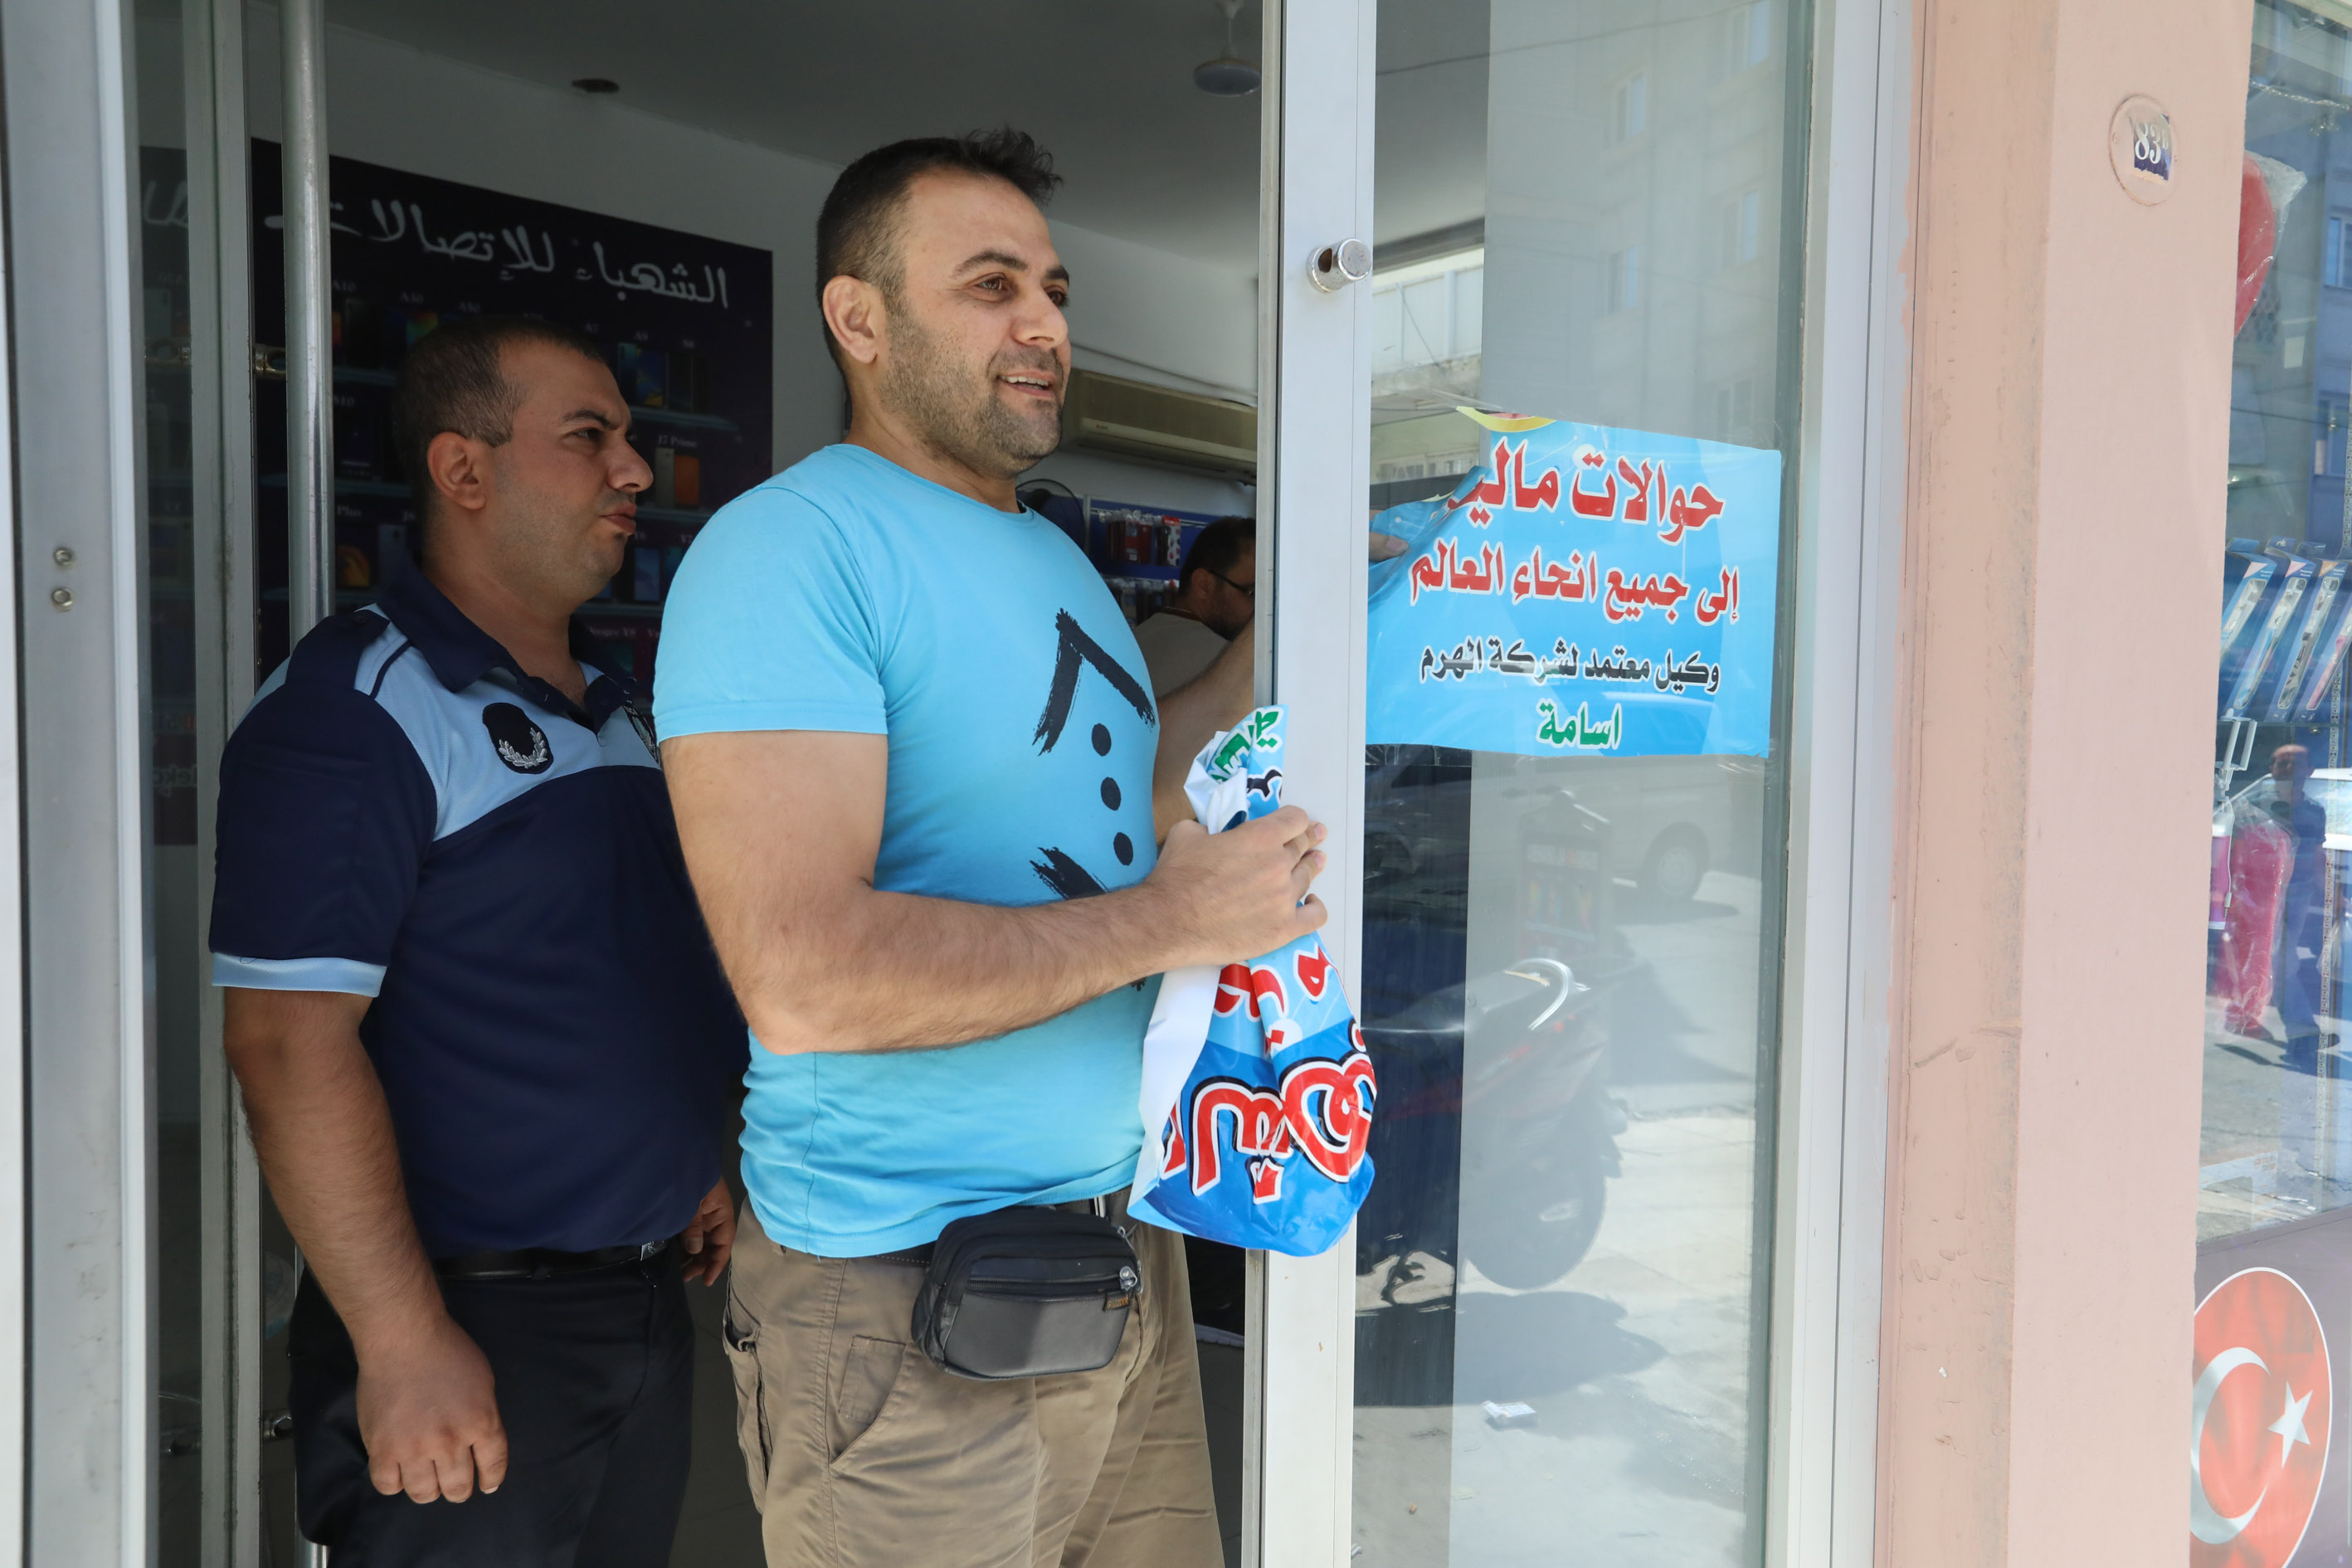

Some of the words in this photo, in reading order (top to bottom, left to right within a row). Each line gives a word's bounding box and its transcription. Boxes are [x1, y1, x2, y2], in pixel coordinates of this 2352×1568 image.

[575, 242, 729, 309] الشهباء
[1439, 440, 1560, 526] مالي
[1571, 453, 1724, 543] حوالات
[1410, 538, 1503, 604] العالم
[1512, 547, 1596, 603] انحاء
[1605, 568, 1689, 623] جميع
[1695, 566, 1739, 623] إلى
[1421, 636, 1483, 683] الهرم
[1489, 637, 1578, 683] لشركة
[1585, 647, 1651, 682] معتمد
[1654, 652, 1720, 693] وكيل
[1537, 702, 1622, 748] اسامة
